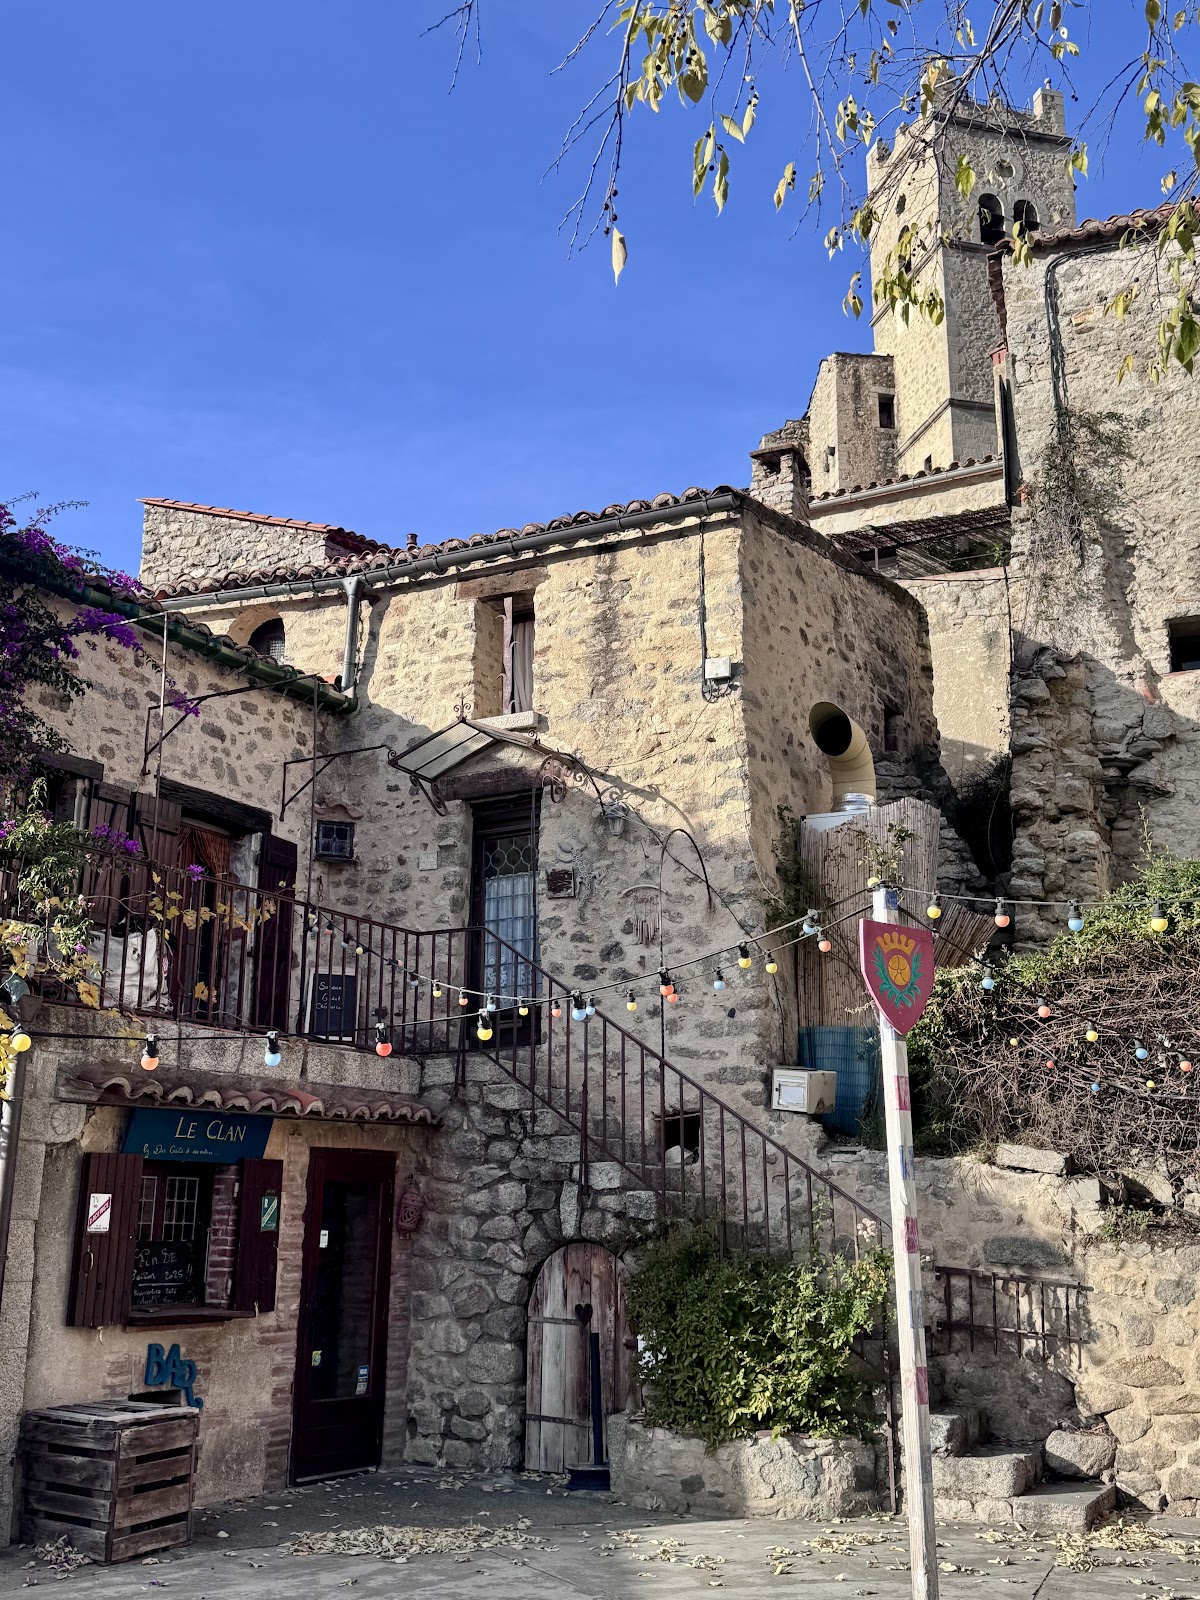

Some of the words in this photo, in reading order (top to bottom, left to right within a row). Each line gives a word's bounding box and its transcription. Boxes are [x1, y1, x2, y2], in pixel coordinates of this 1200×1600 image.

[174, 1116, 198, 1139] LE
[206, 1119, 247, 1142] CLAN
[144, 1343, 204, 1410] BAR
